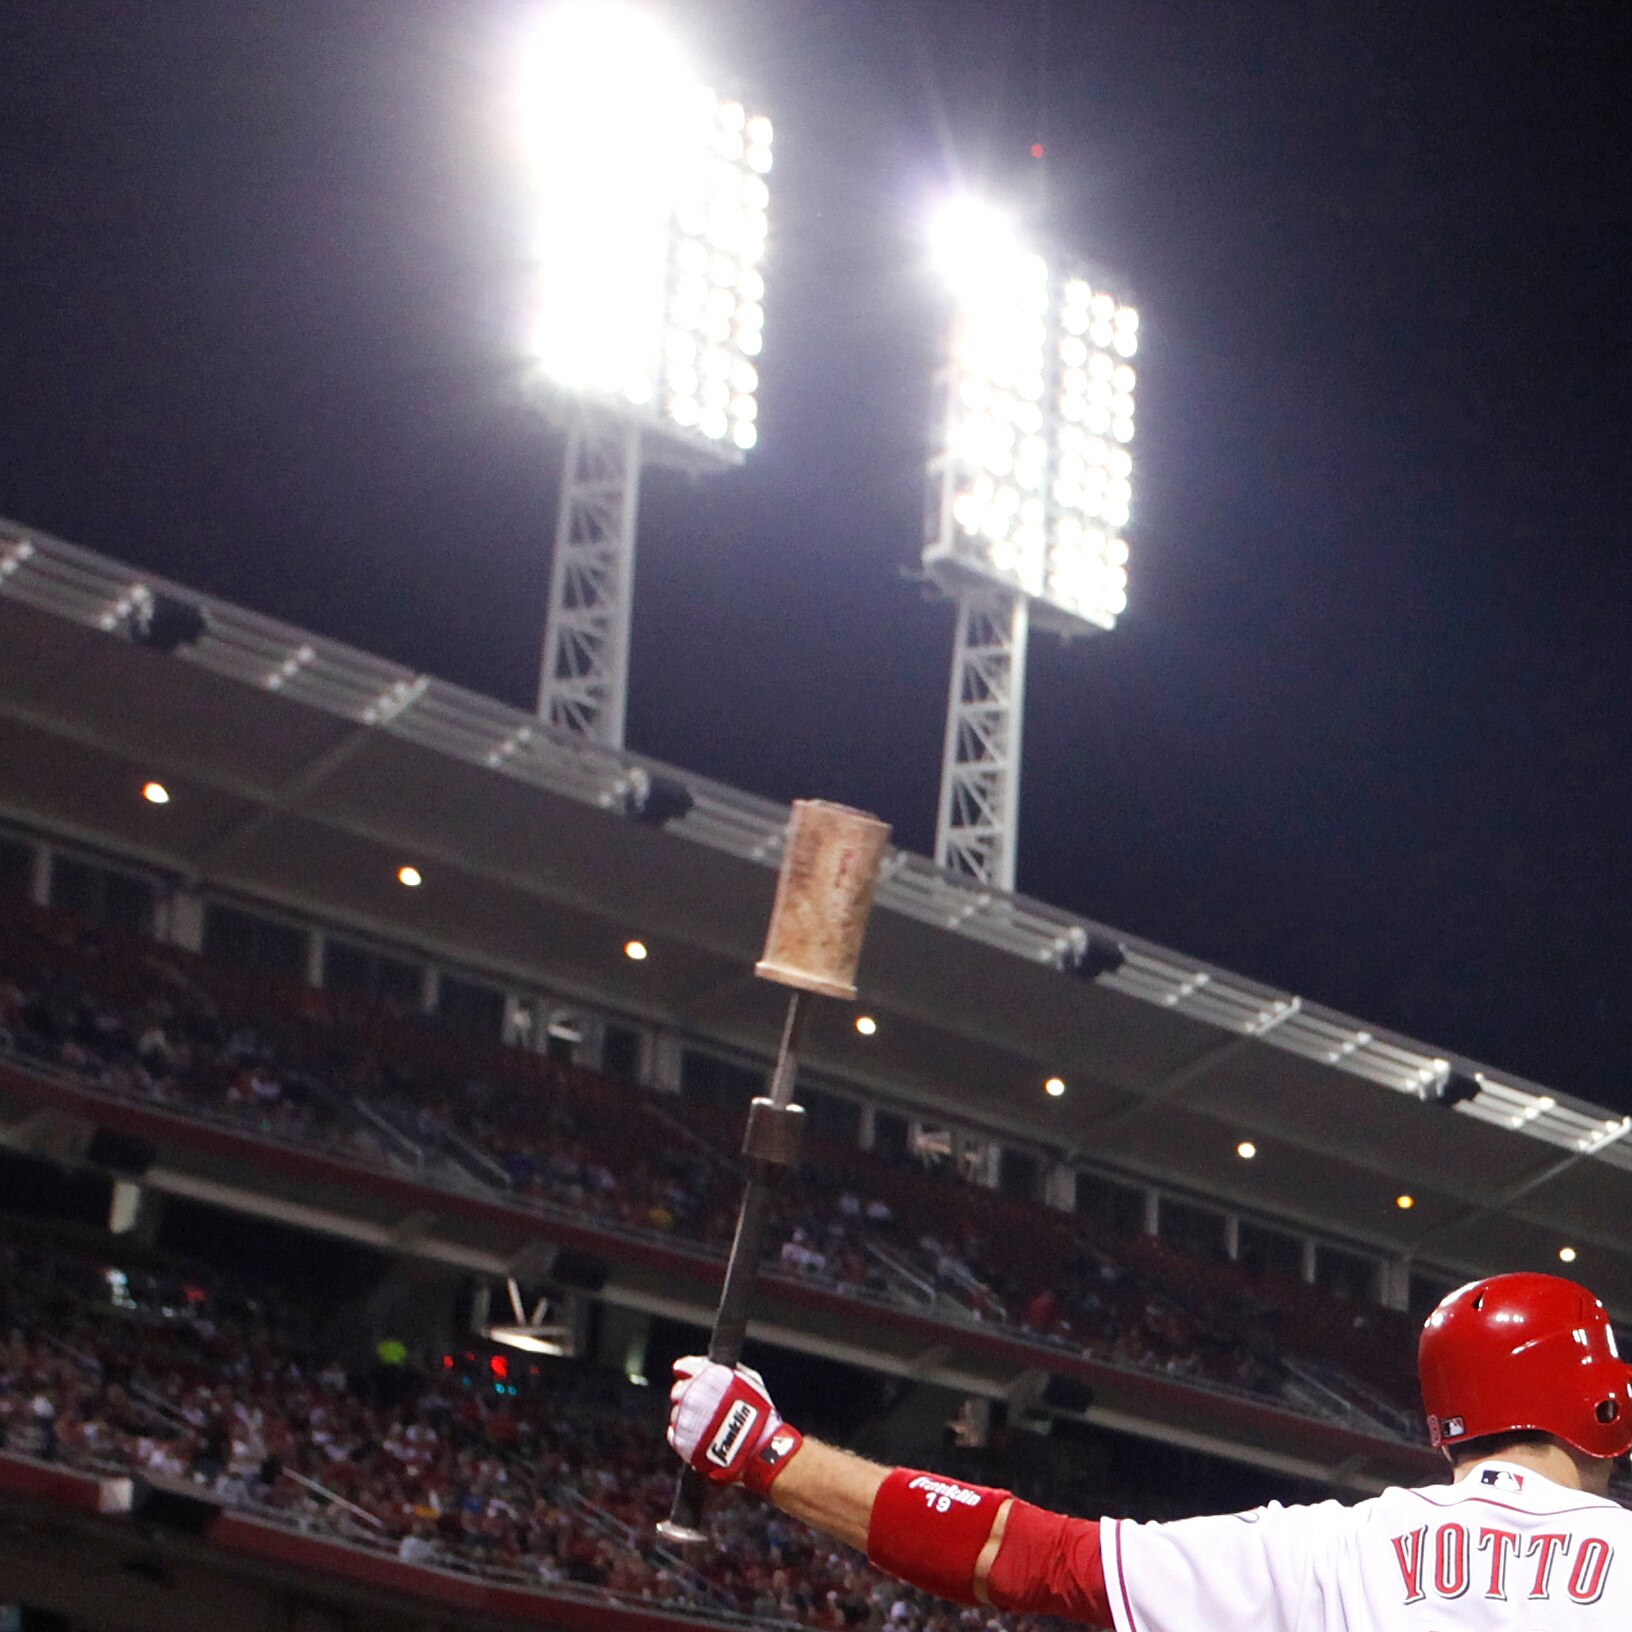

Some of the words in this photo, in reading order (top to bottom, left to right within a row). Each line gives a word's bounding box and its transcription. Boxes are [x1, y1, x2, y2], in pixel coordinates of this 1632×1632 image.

[908, 1475, 982, 1507] Franklin
[925, 1491, 951, 1513] 19
[1391, 1522, 1614, 1605] VOTTO
